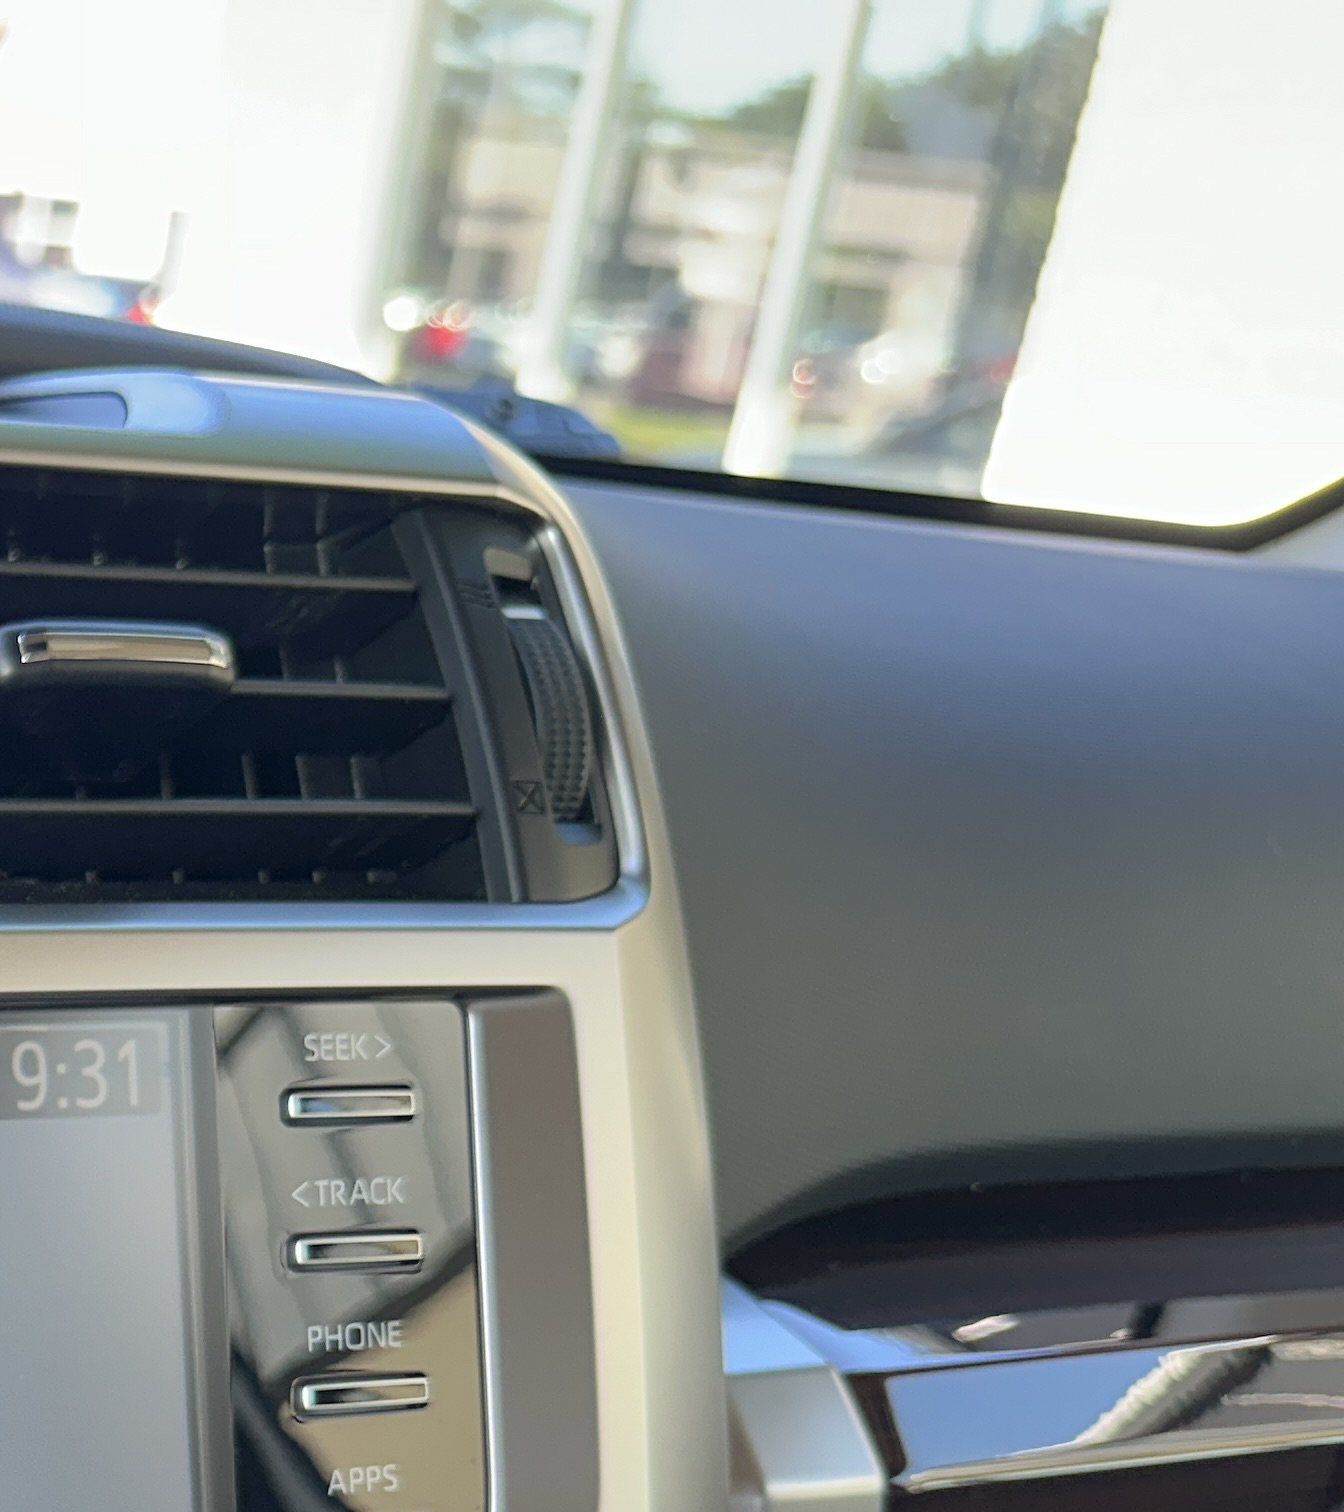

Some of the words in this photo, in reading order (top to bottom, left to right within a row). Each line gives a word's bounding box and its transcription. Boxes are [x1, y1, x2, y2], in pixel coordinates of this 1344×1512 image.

[304, 1032, 367, 1061] SEEK
[11, 1038, 140, 1112] 9:31
[313, 1175, 405, 1207] TRACK
[306, 1319, 404, 1352] PHONE
[326, 1464, 401, 1498] APPS
